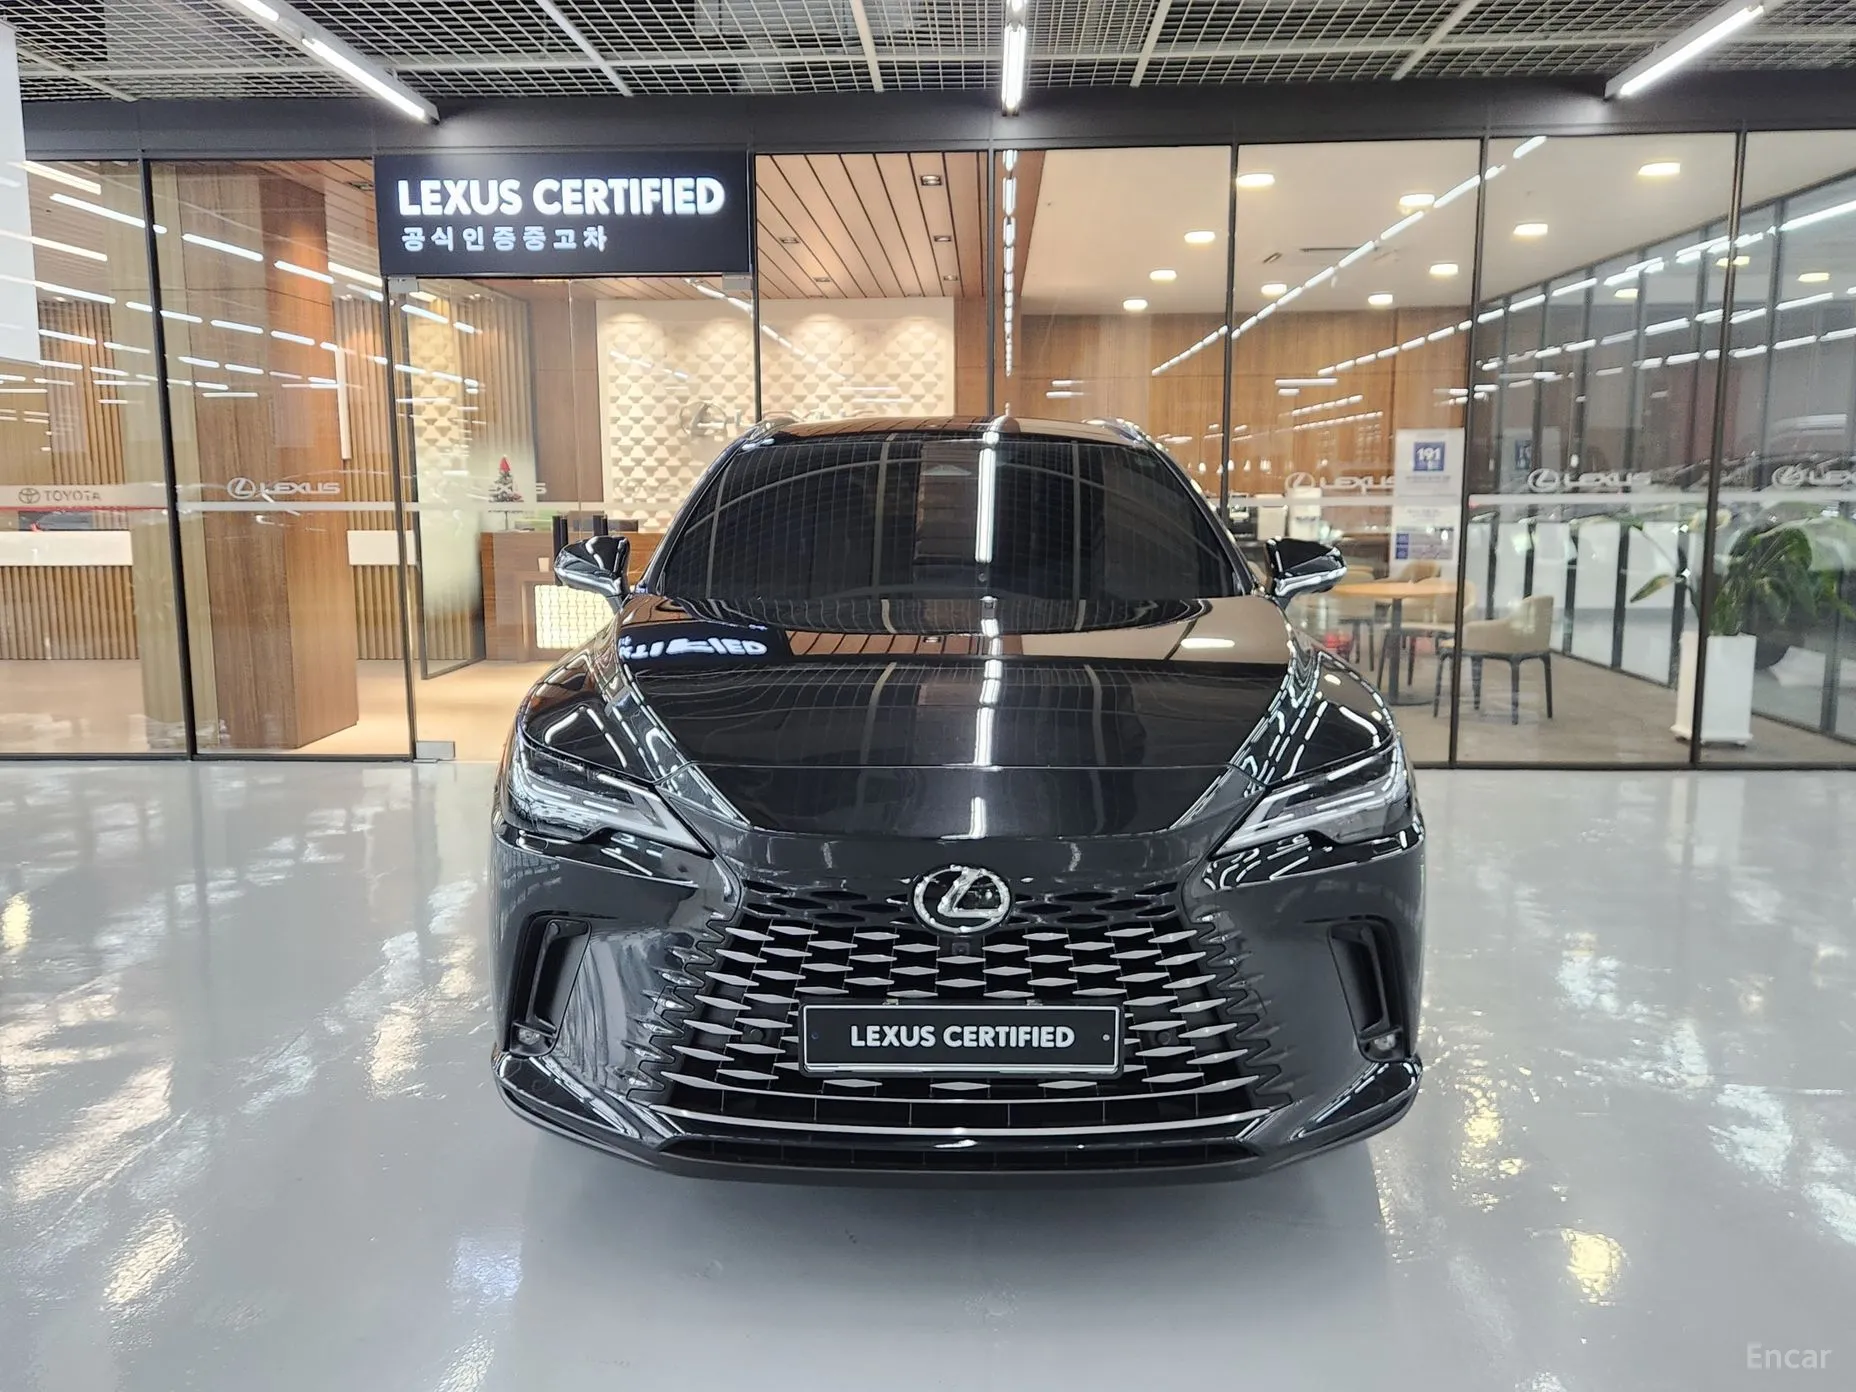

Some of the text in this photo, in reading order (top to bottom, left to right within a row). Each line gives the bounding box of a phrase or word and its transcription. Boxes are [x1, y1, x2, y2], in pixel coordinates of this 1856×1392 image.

[397, 177, 726, 216] LEXUS CERTIFIED
[44, 489, 101, 502] TOYOTA
[260, 481, 341, 495] LEXUS
[850, 1025, 1075, 1048] LEXUS CERTIFIED
